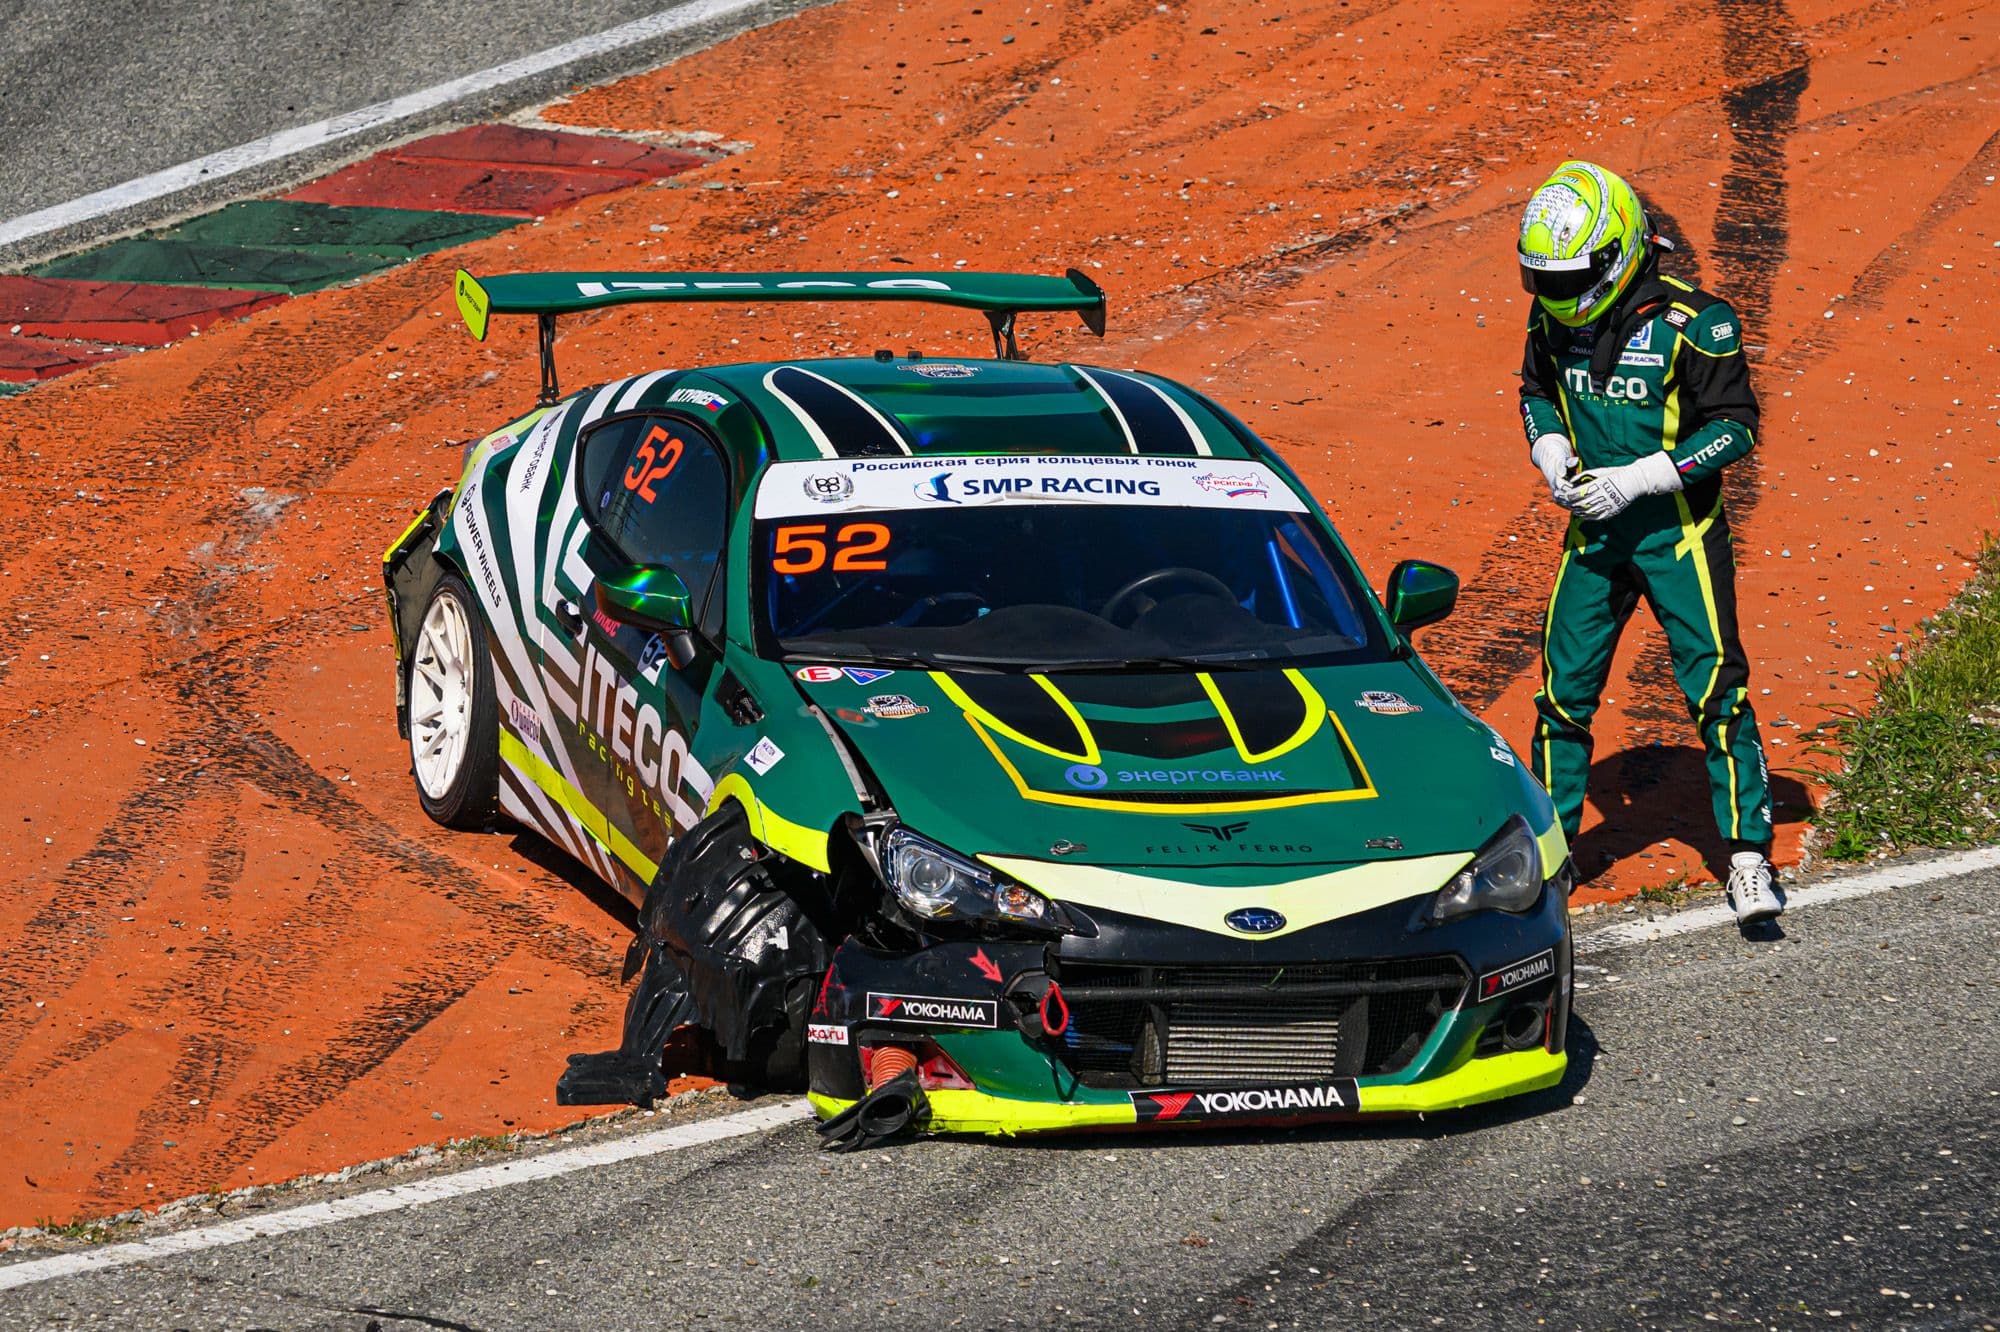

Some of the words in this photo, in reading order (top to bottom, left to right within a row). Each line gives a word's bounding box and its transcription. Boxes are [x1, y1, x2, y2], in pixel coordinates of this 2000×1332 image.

[1667, 311, 1686, 324] OMP
[1711, 325, 1733, 337] OMP
[1694, 434, 1733, 464] ITECO
[624, 425, 684, 504] 52
[852, 458, 966, 472] Российская
[974, 457, 1030, 468] серия
[1037, 457, 1140, 466] кольцевых
[1147, 458, 1198, 468] гонок
[963, 478, 1033, 496] SMP
[1041, 477, 1161, 496] RACING
[464, 505, 484, 550] POWER
[478, 548, 501, 609] WHEELS
[773, 523, 891, 574] 52
[1118, 767, 1287, 785] энергобанк
[1146, 844, 1220, 854] FELIX
[1239, 843, 1312, 853] FERRO
[1501, 958, 1549, 987] YOKOHAMA
[902, 1001, 985, 1021] YOKOHAMA
[1196, 1085, 1345, 1114] YOKOHAMA
